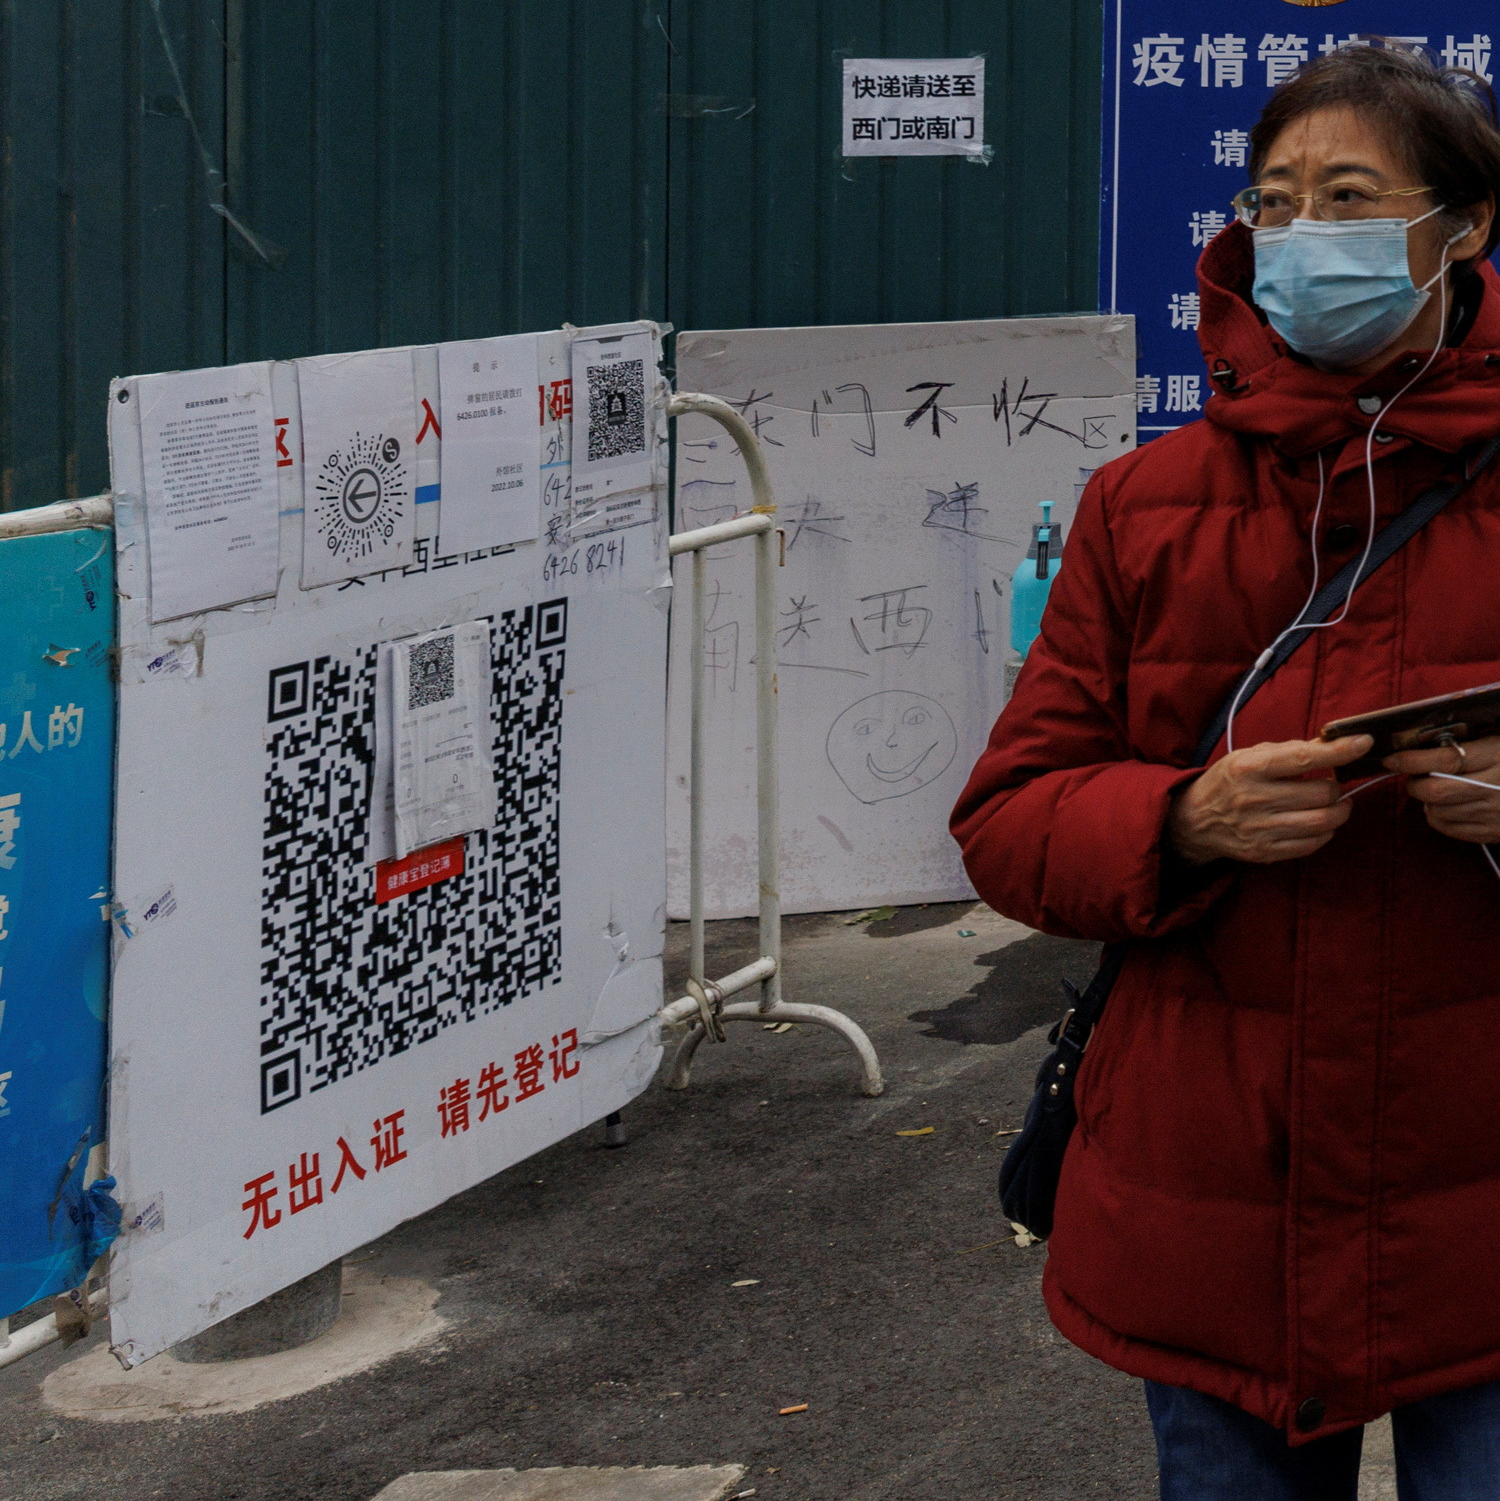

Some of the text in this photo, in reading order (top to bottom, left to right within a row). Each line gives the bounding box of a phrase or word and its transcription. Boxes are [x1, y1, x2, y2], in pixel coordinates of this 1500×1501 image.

[852, 74, 976, 99] 快递请送至
[851, 116, 975, 141] 西门或南门
[242, 1027, 580, 1240] 无出入证 请先登记
